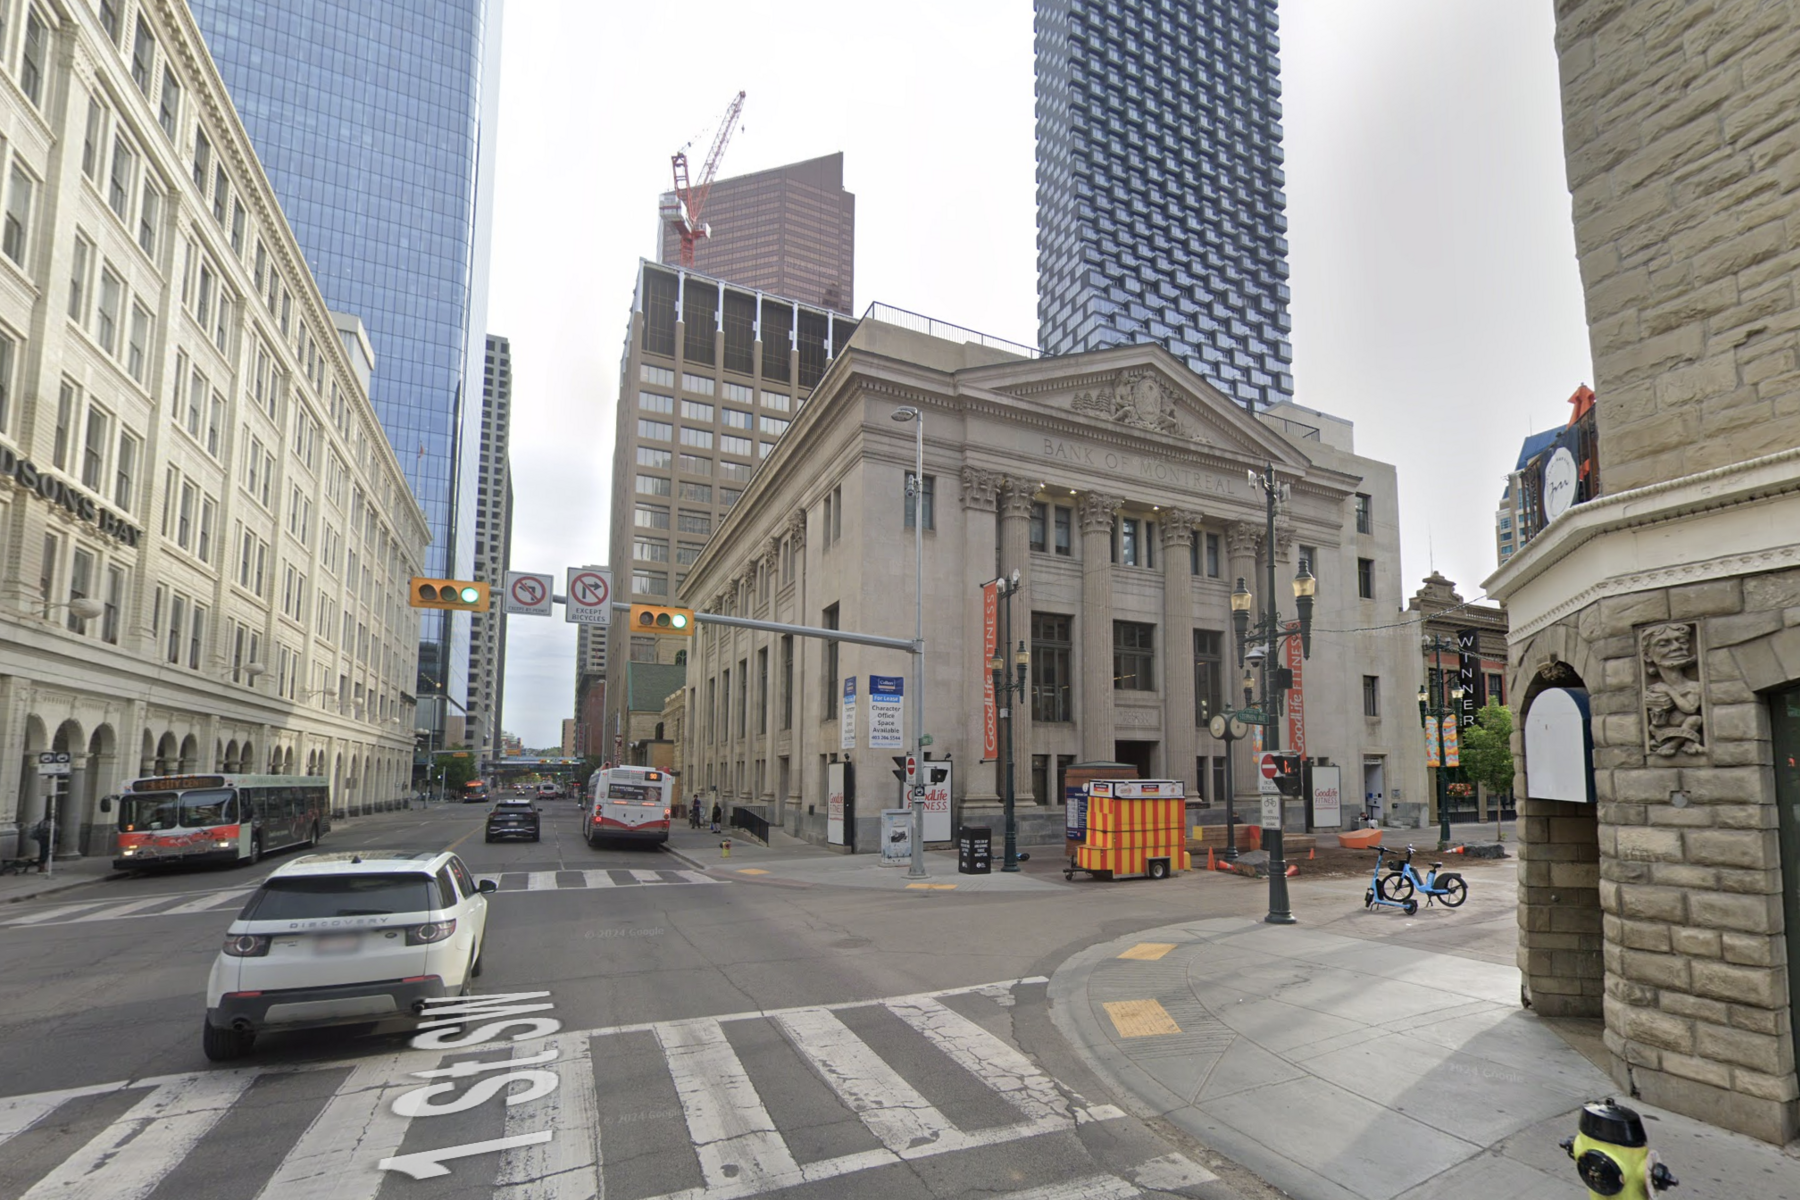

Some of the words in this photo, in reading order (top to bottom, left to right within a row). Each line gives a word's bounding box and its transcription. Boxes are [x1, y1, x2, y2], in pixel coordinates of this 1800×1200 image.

[1043, 438, 1093, 465] BANK
[1105, 453, 1129, 471] OF
[1140, 460, 1234, 494] MONTREAL
[99, 507, 143, 549] BAY
[572, 614, 605, 622] BICYCLES
[986, 592, 995, 668] FITNESS
[1291, 622, 1302, 690] FITNESS
[984, 675, 995, 751] GoodLife
[1290, 694, 1304, 755] GoodLife
[162, 780, 180, 789] CITY
[907, 801, 948, 810] FNESS
[1315, 788, 1337, 798] GoodLife
[289, 918, 389, 929] DISCOVERY
